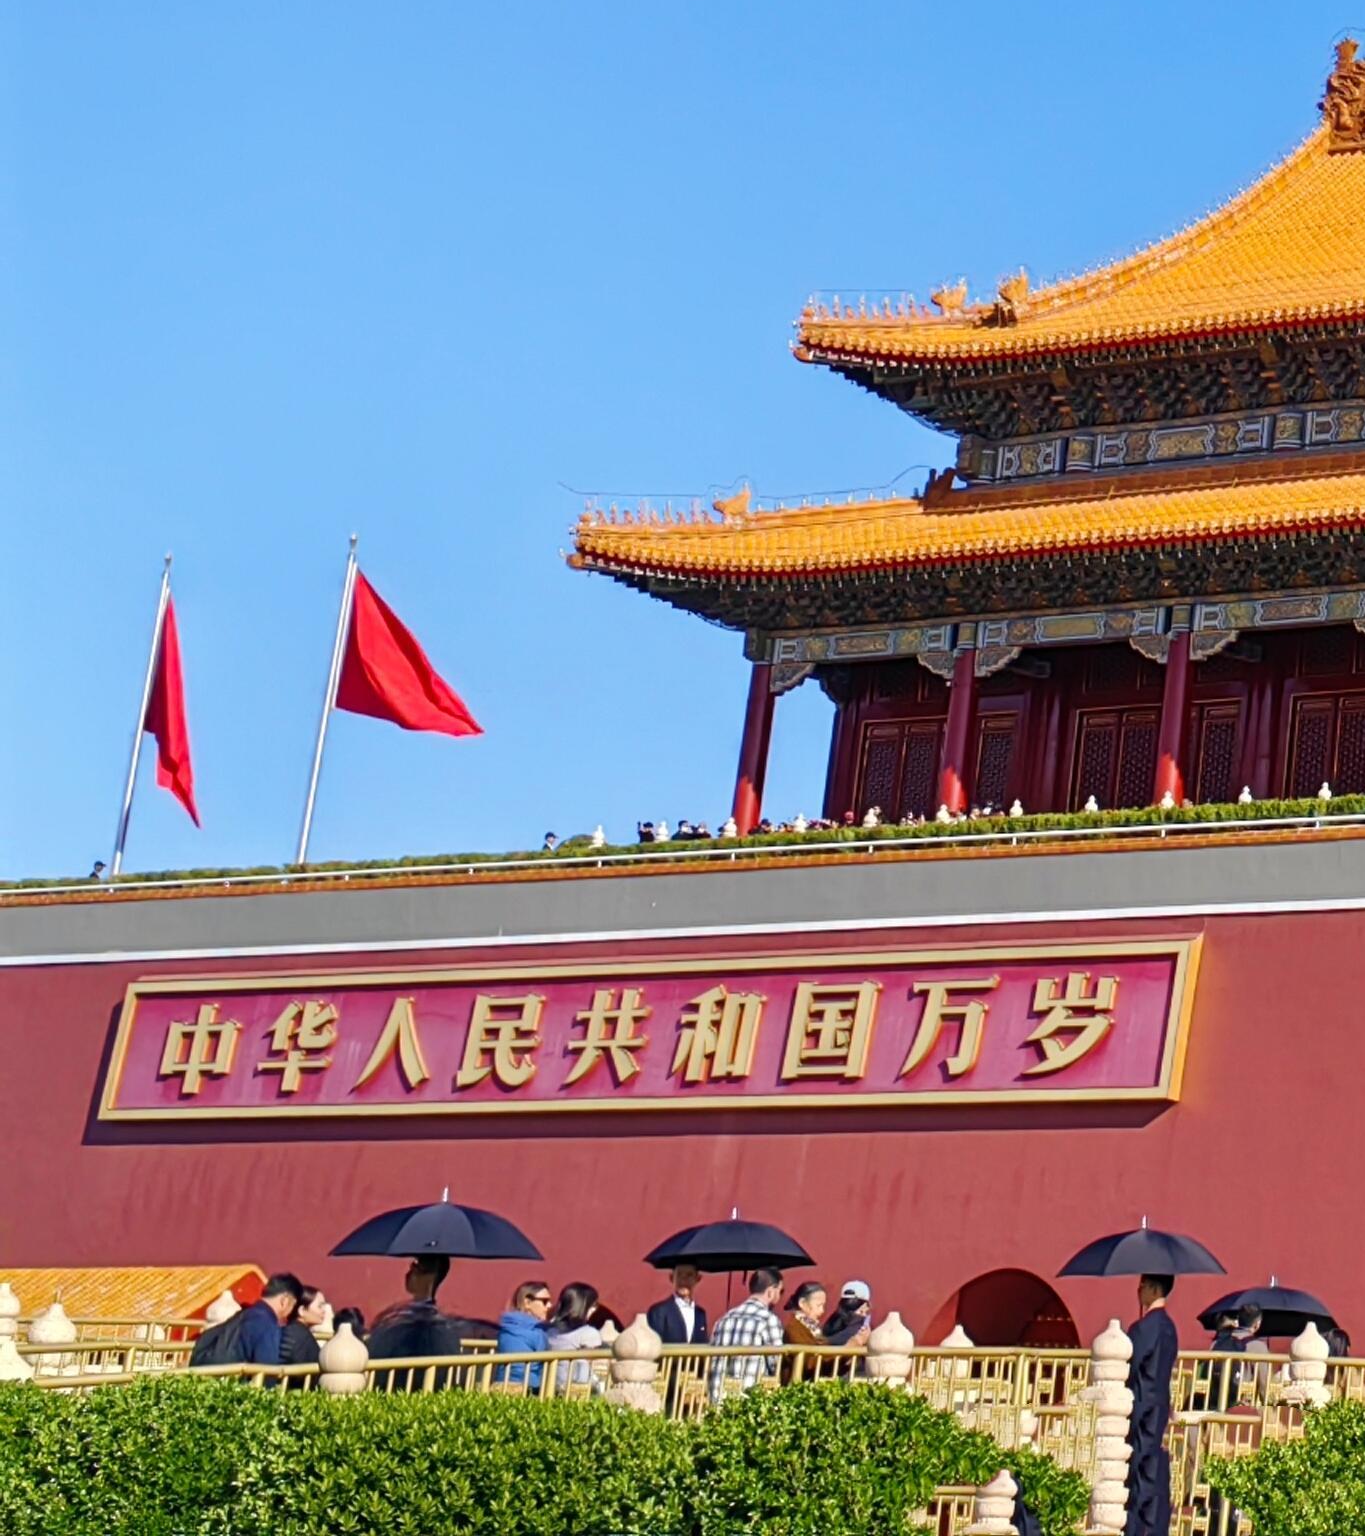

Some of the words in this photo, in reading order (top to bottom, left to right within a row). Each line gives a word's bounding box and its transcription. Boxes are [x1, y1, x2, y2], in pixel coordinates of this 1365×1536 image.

[159, 971, 1118, 1095] 中华人民共和国万岁
